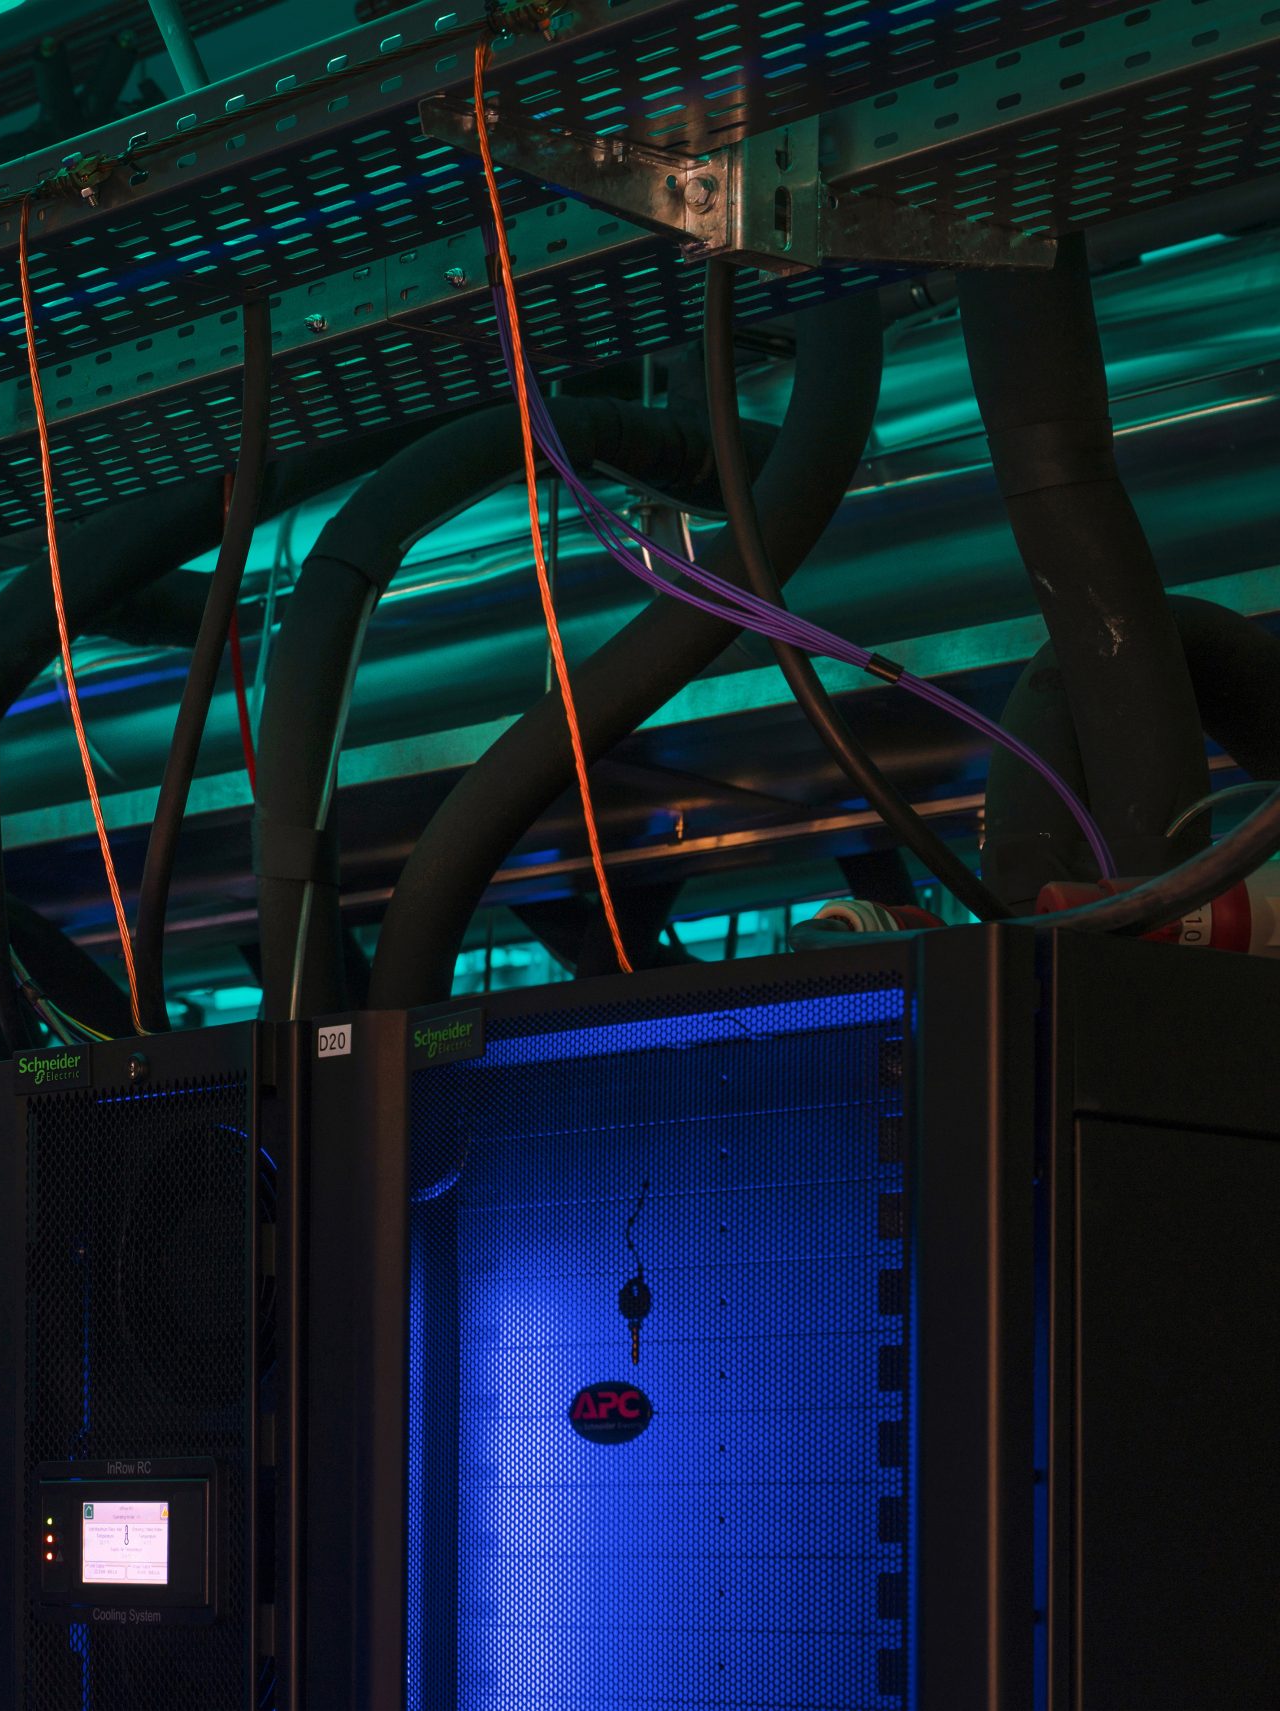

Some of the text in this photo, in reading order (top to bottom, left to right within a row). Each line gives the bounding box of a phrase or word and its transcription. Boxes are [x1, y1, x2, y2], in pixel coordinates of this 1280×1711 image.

[319, 1032, 345, 1051] D20
[414, 1021, 472, 1048] Schneider
[19, 1052, 81, 1073] Schneider
[46, 1070, 80, 1082] Electric
[572, 1390, 641, 1420] APC
[107, 1461, 152, 1475] InRow RC
[93, 1608, 161, 1624] Cooling System
